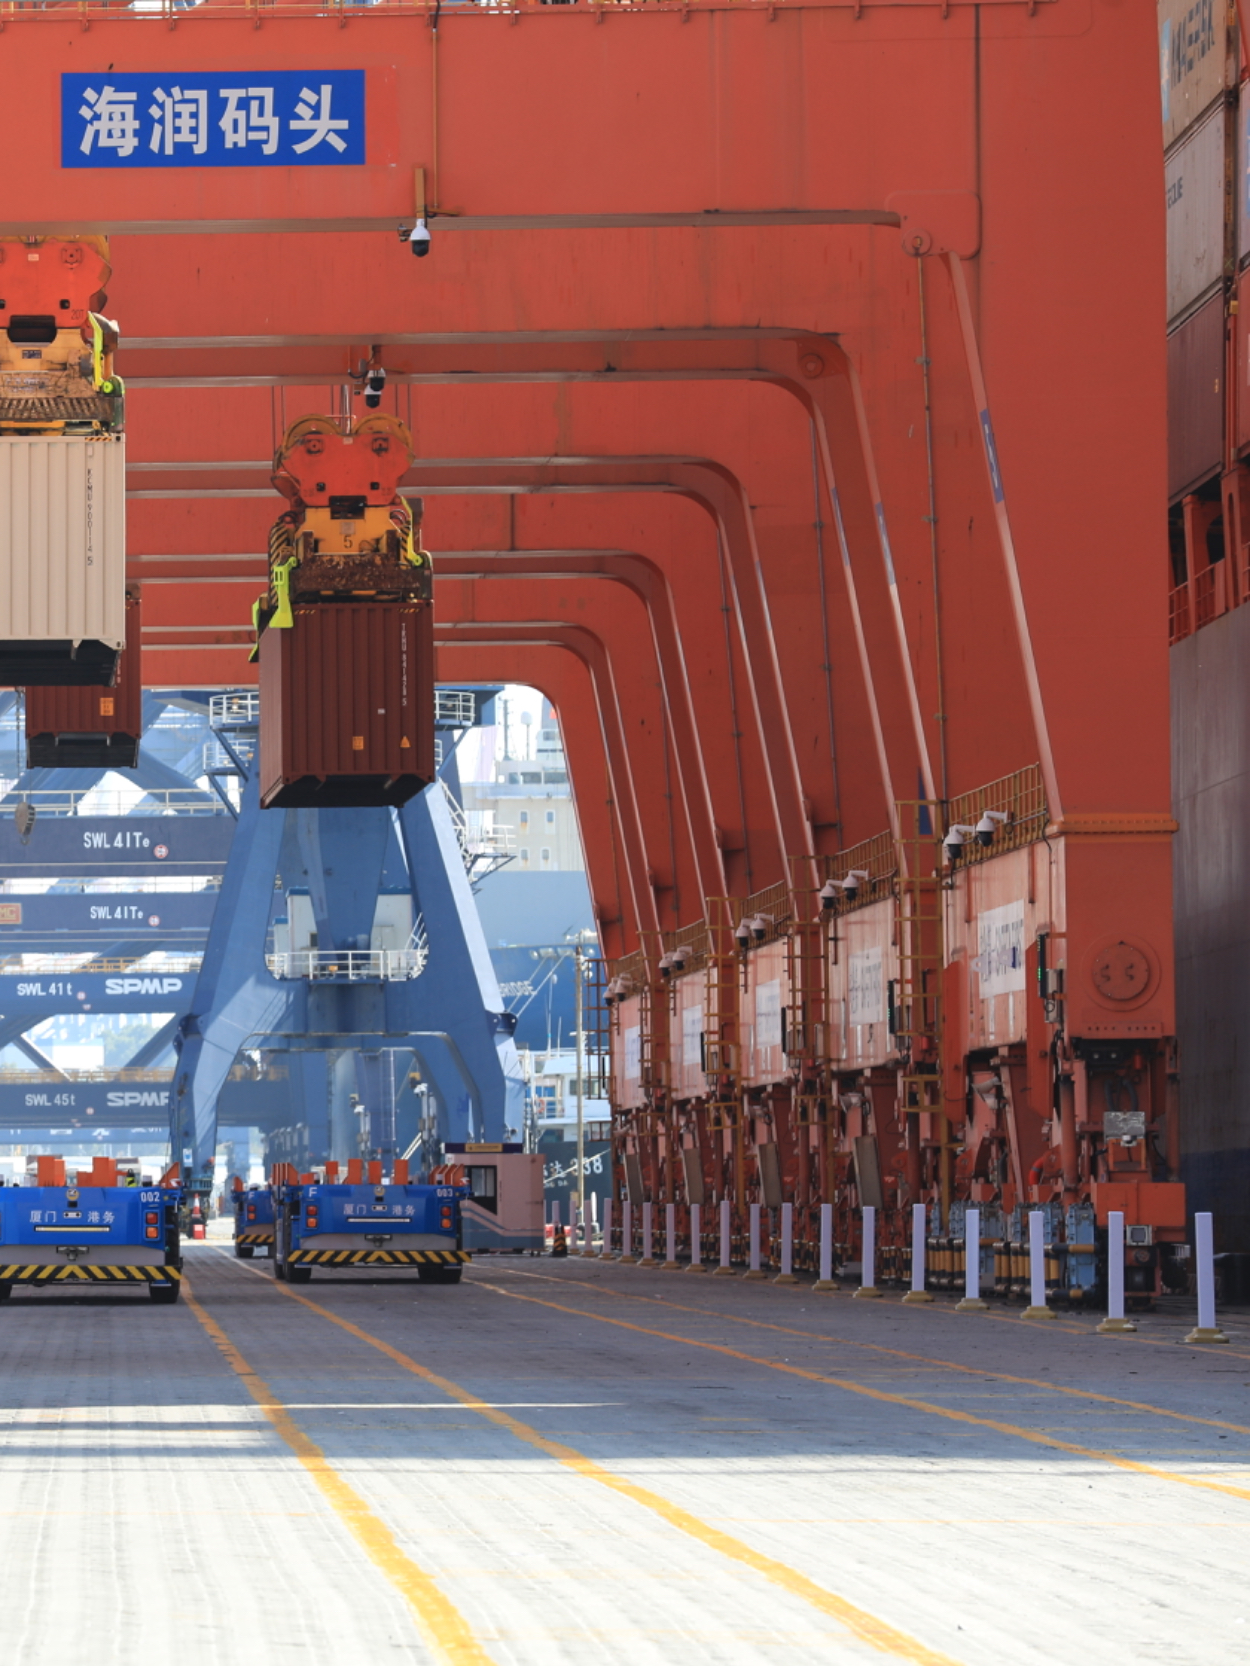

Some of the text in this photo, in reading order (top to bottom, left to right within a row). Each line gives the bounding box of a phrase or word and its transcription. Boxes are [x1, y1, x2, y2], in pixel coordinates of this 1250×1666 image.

[78, 84, 349, 157] 海润码头
[343, 536, 353, 549] 5
[16, 983, 46, 996] SWL
[105, 978, 182, 995] SPMP
[25, 1094, 51, 1106] SWL
[140, 1191, 160, 1203] 002
[308, 1187, 318, 1197] F
[436, 1188, 453, 1198] 003
